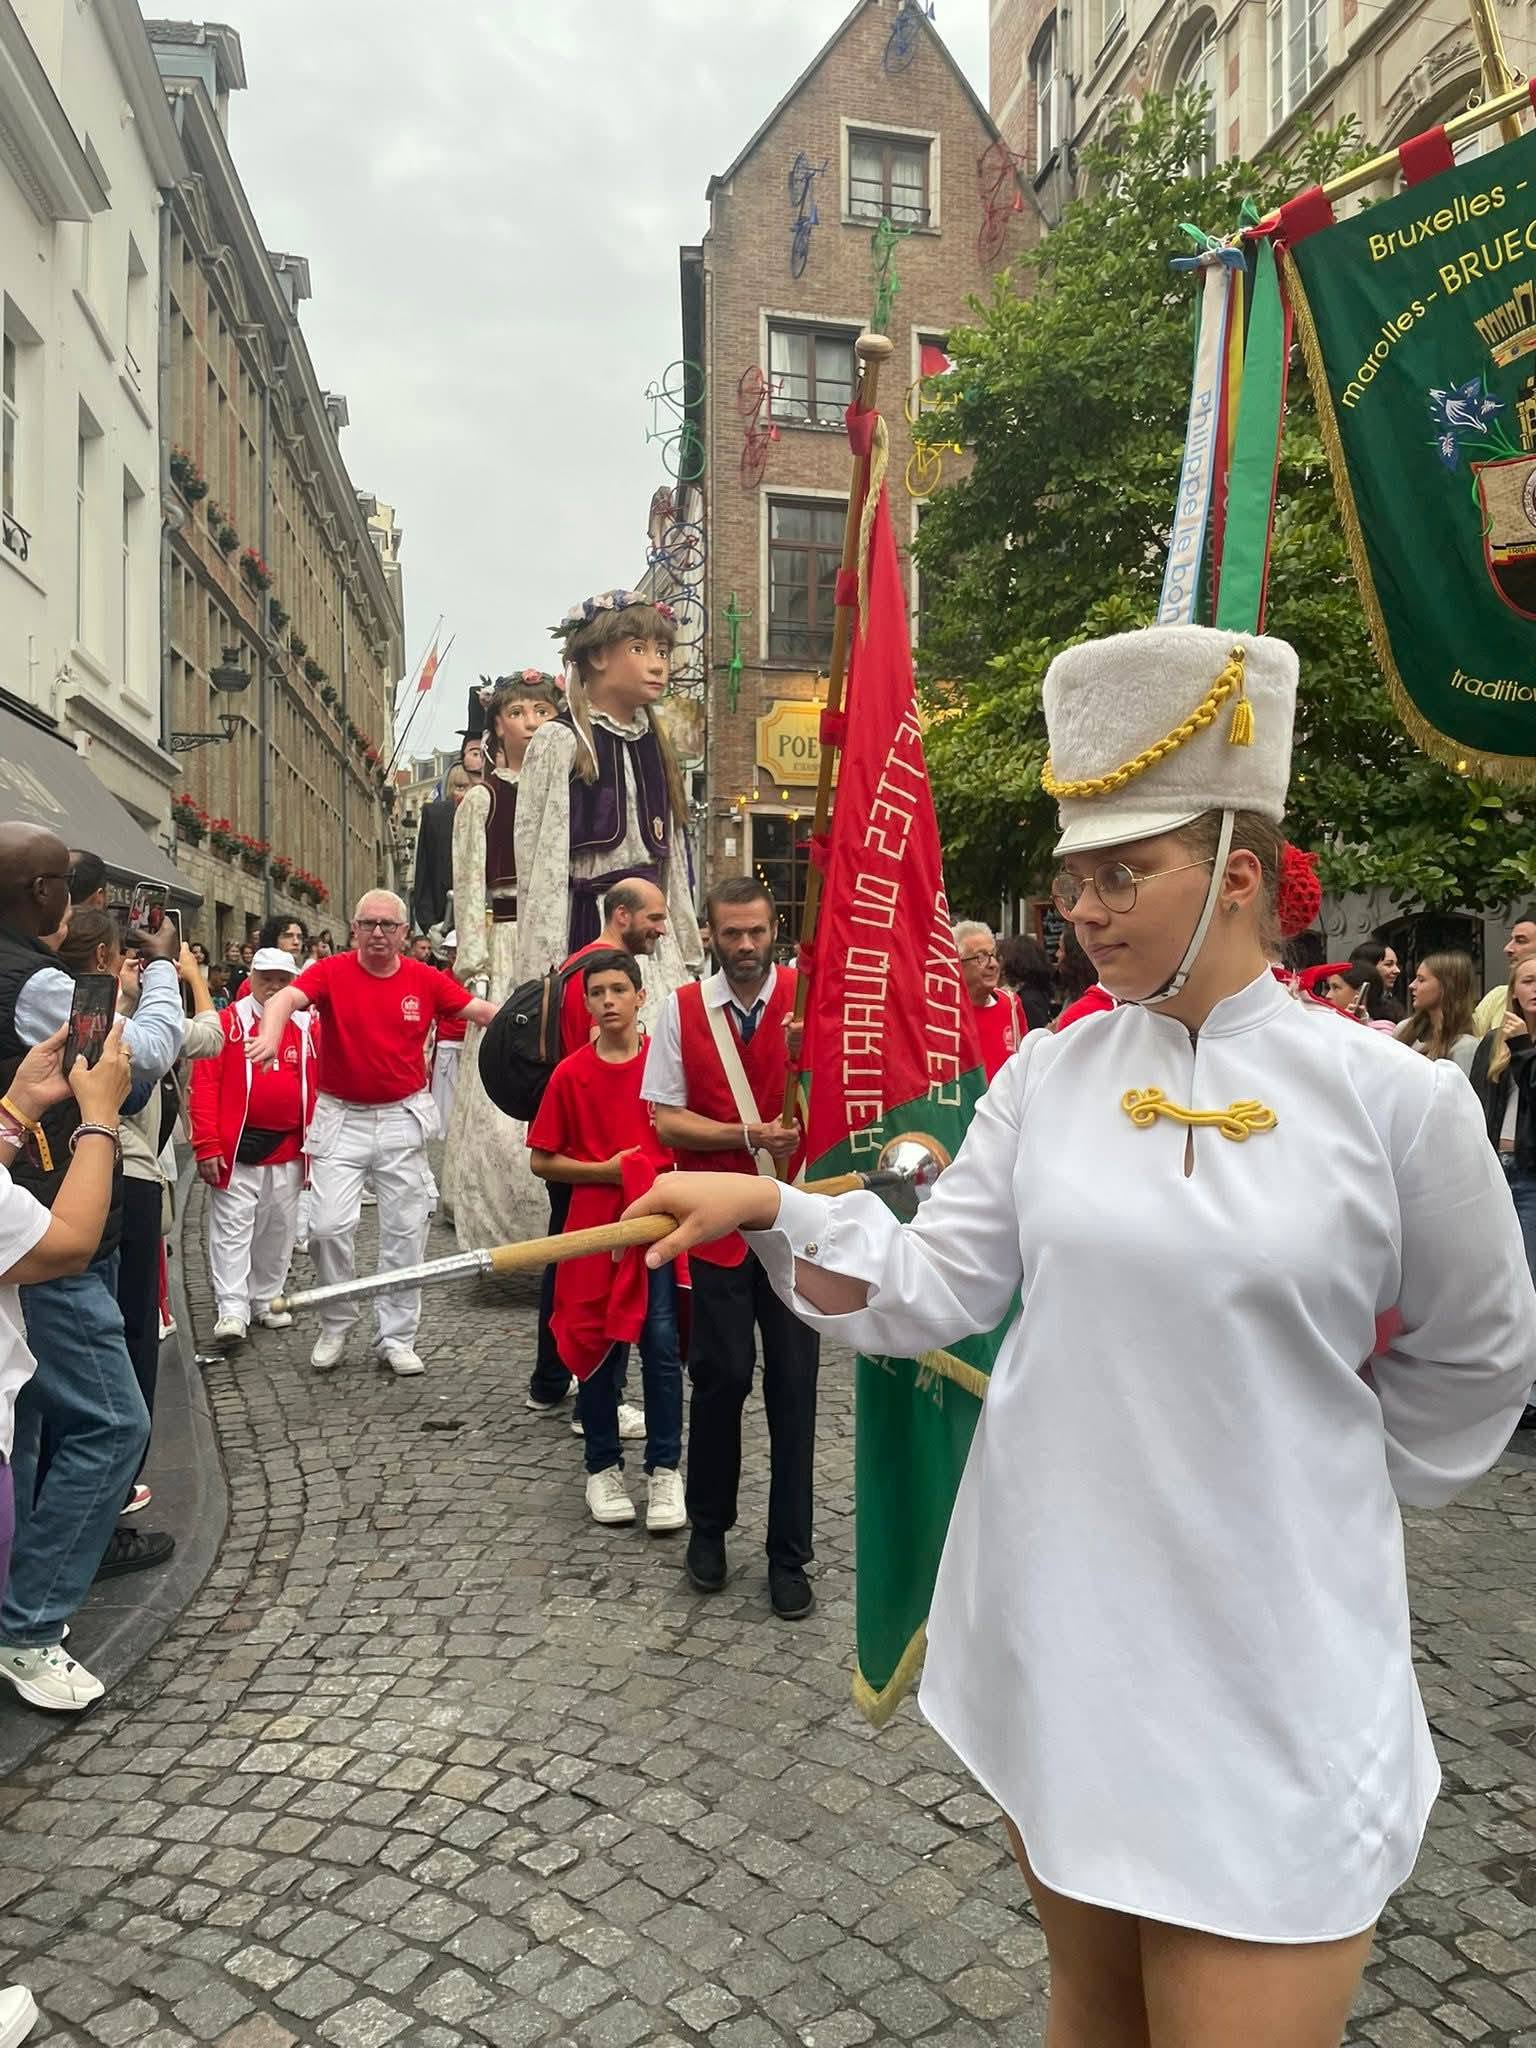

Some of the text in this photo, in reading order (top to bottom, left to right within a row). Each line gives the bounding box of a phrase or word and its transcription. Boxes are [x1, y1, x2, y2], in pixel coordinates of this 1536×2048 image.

[1368, 185, 1506, 262] Bruxelles
[1342, 299, 1426, 409] marolles
[1176, 526, 1199, 553] le
[1450, 668, 1536, 702] traditio
